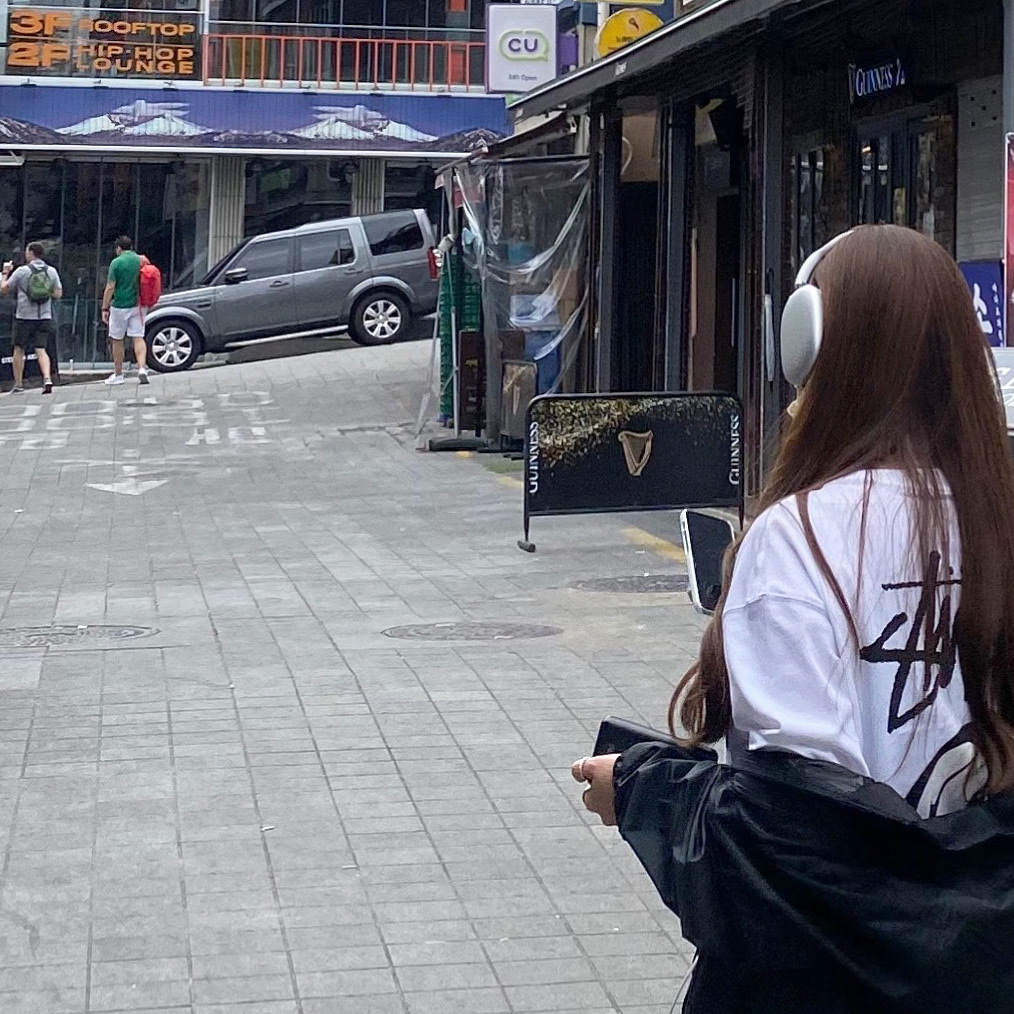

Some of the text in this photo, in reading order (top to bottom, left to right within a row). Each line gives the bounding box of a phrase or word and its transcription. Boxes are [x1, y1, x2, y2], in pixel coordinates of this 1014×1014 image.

[10, 9, 196, 36] 3F ROOFTOP
[8, 42, 71, 67] 2F
[508, 38, 538, 52] CU
[77, 58, 194, 75] LOUNGE
[729, 414, 740, 485] GUINNESS
